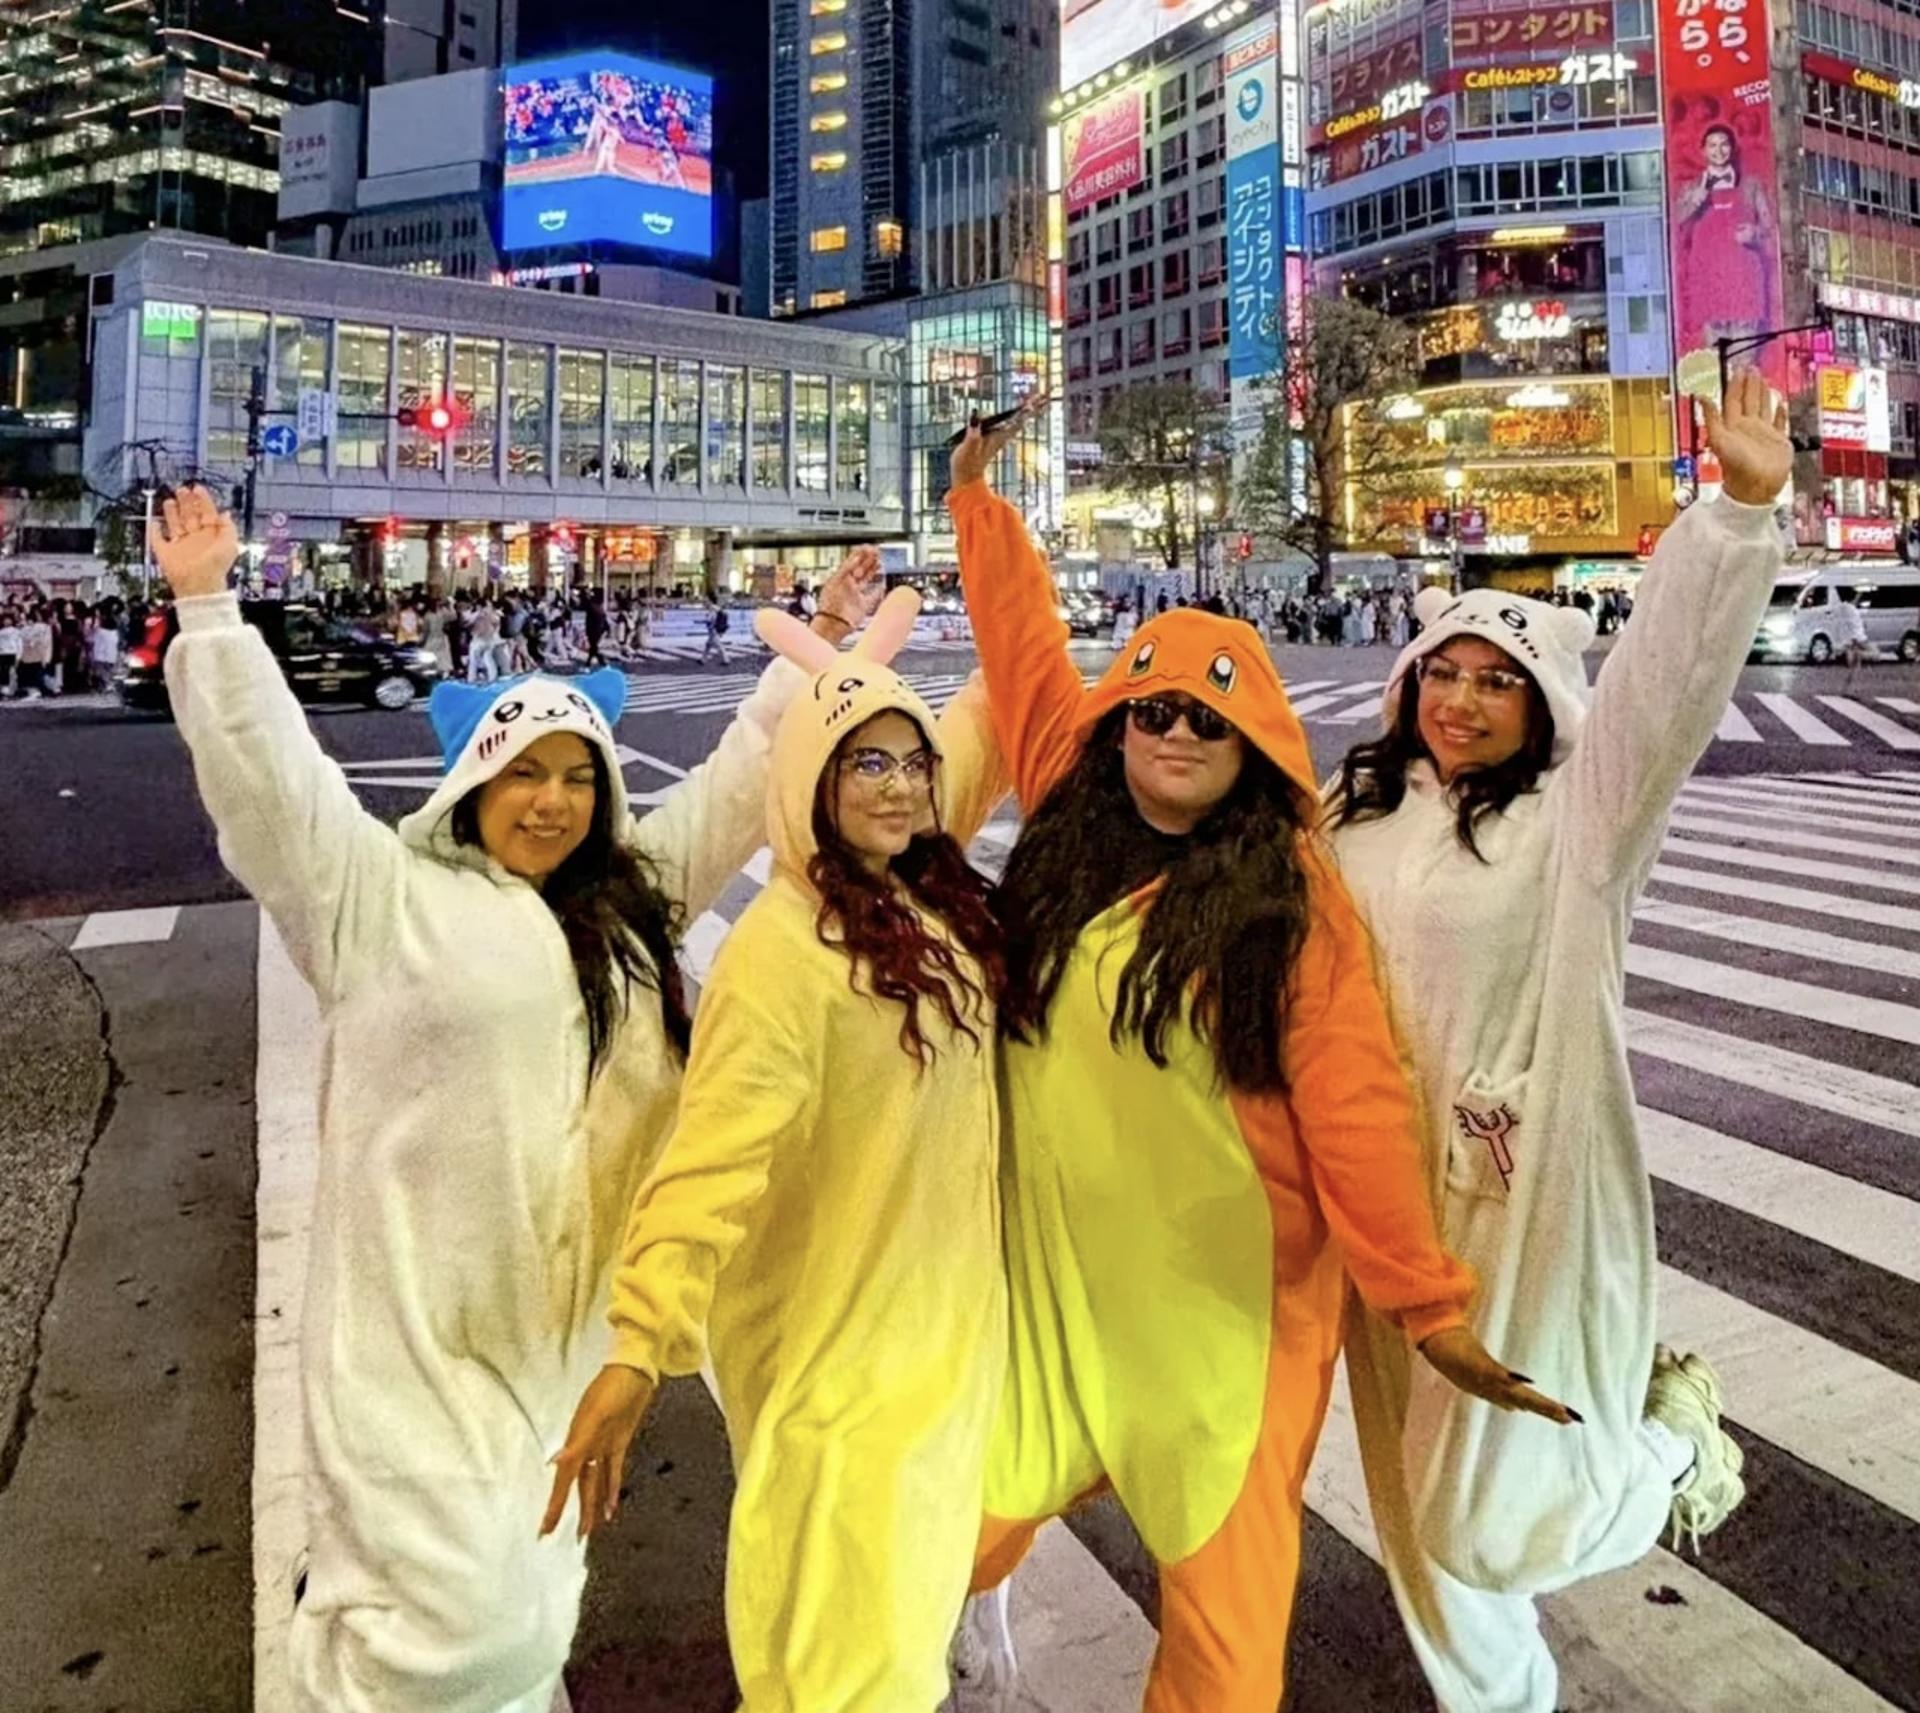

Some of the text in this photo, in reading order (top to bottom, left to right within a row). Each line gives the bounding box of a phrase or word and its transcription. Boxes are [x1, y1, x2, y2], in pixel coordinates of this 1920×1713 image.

[1454, 8, 1608, 47] コンタクト
[1559, 53, 1638, 85] ガスト
[1380, 80, 1431, 121] ガスト
[1361, 126, 1417, 171] ガスト
[1232, 182, 1266, 340] アイシティ
